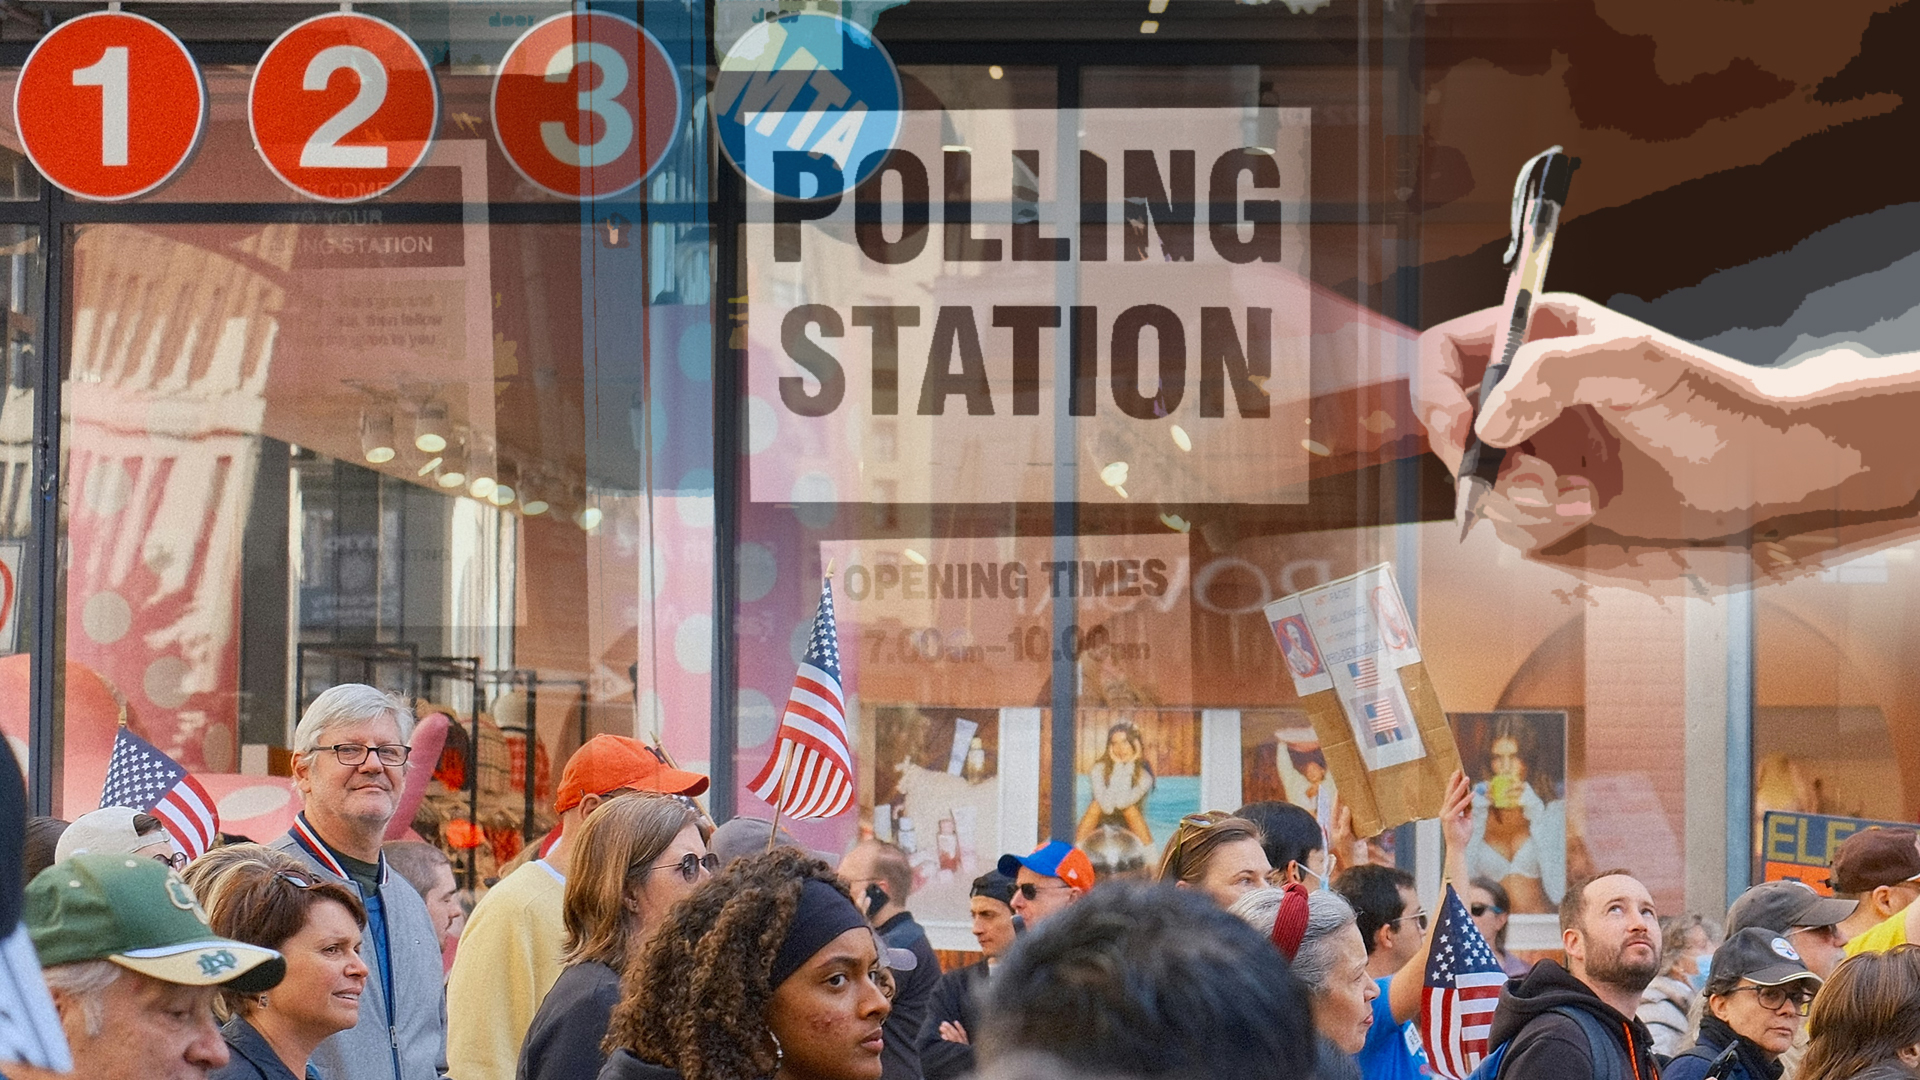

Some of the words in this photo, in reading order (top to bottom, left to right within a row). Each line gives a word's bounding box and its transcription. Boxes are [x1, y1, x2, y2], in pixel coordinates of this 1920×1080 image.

[72, 46, 129, 167] 1
[299, 45, 389, 168] 2
[539, 42, 634, 167] 3
[715, 20, 869, 171] MTA
[338, 236, 433, 254] STATION
[772, 147, 1283, 264] POLLING
[779, 304, 1273, 418] STATION
[843, 561, 1029, 600] OPENING
[1041, 558, 1169, 598] TIMES
